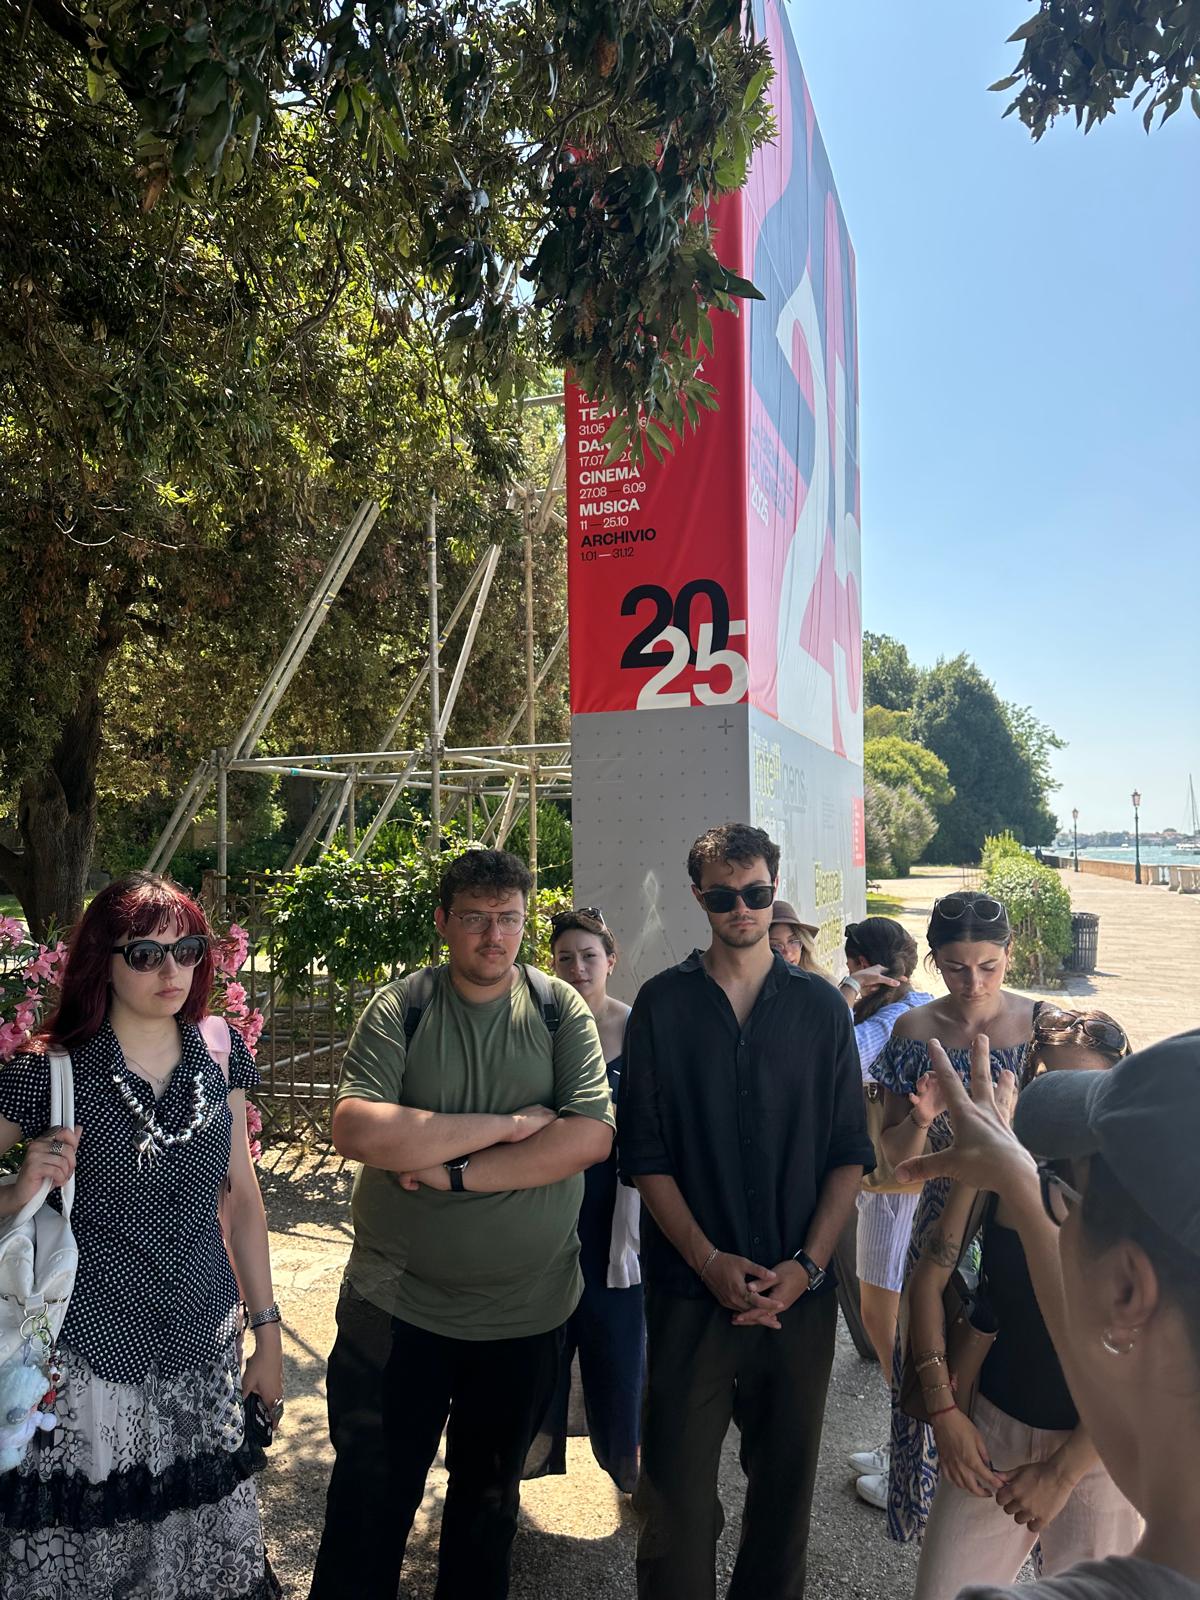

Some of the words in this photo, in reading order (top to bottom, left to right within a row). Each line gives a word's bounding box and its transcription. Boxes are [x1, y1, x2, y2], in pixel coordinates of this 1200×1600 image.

[579, 423, 605, 436] 31.05
[579, 454, 605, 467] 17.07
[578, 465, 641, 485] CINEMA
[579, 486, 607, 499] 27.08
[622, 481, 646, 495] 6.09
[579, 498, 641, 517] MUSICA
[579, 520, 588, 530] 11
[603, 515, 629, 529] 25.10
[580, 528, 657, 548] ARCHIVIO
[612, 546, 635, 559] 31.12
[620, 578, 730, 669] 20
[635, 619, 749, 711] 25
